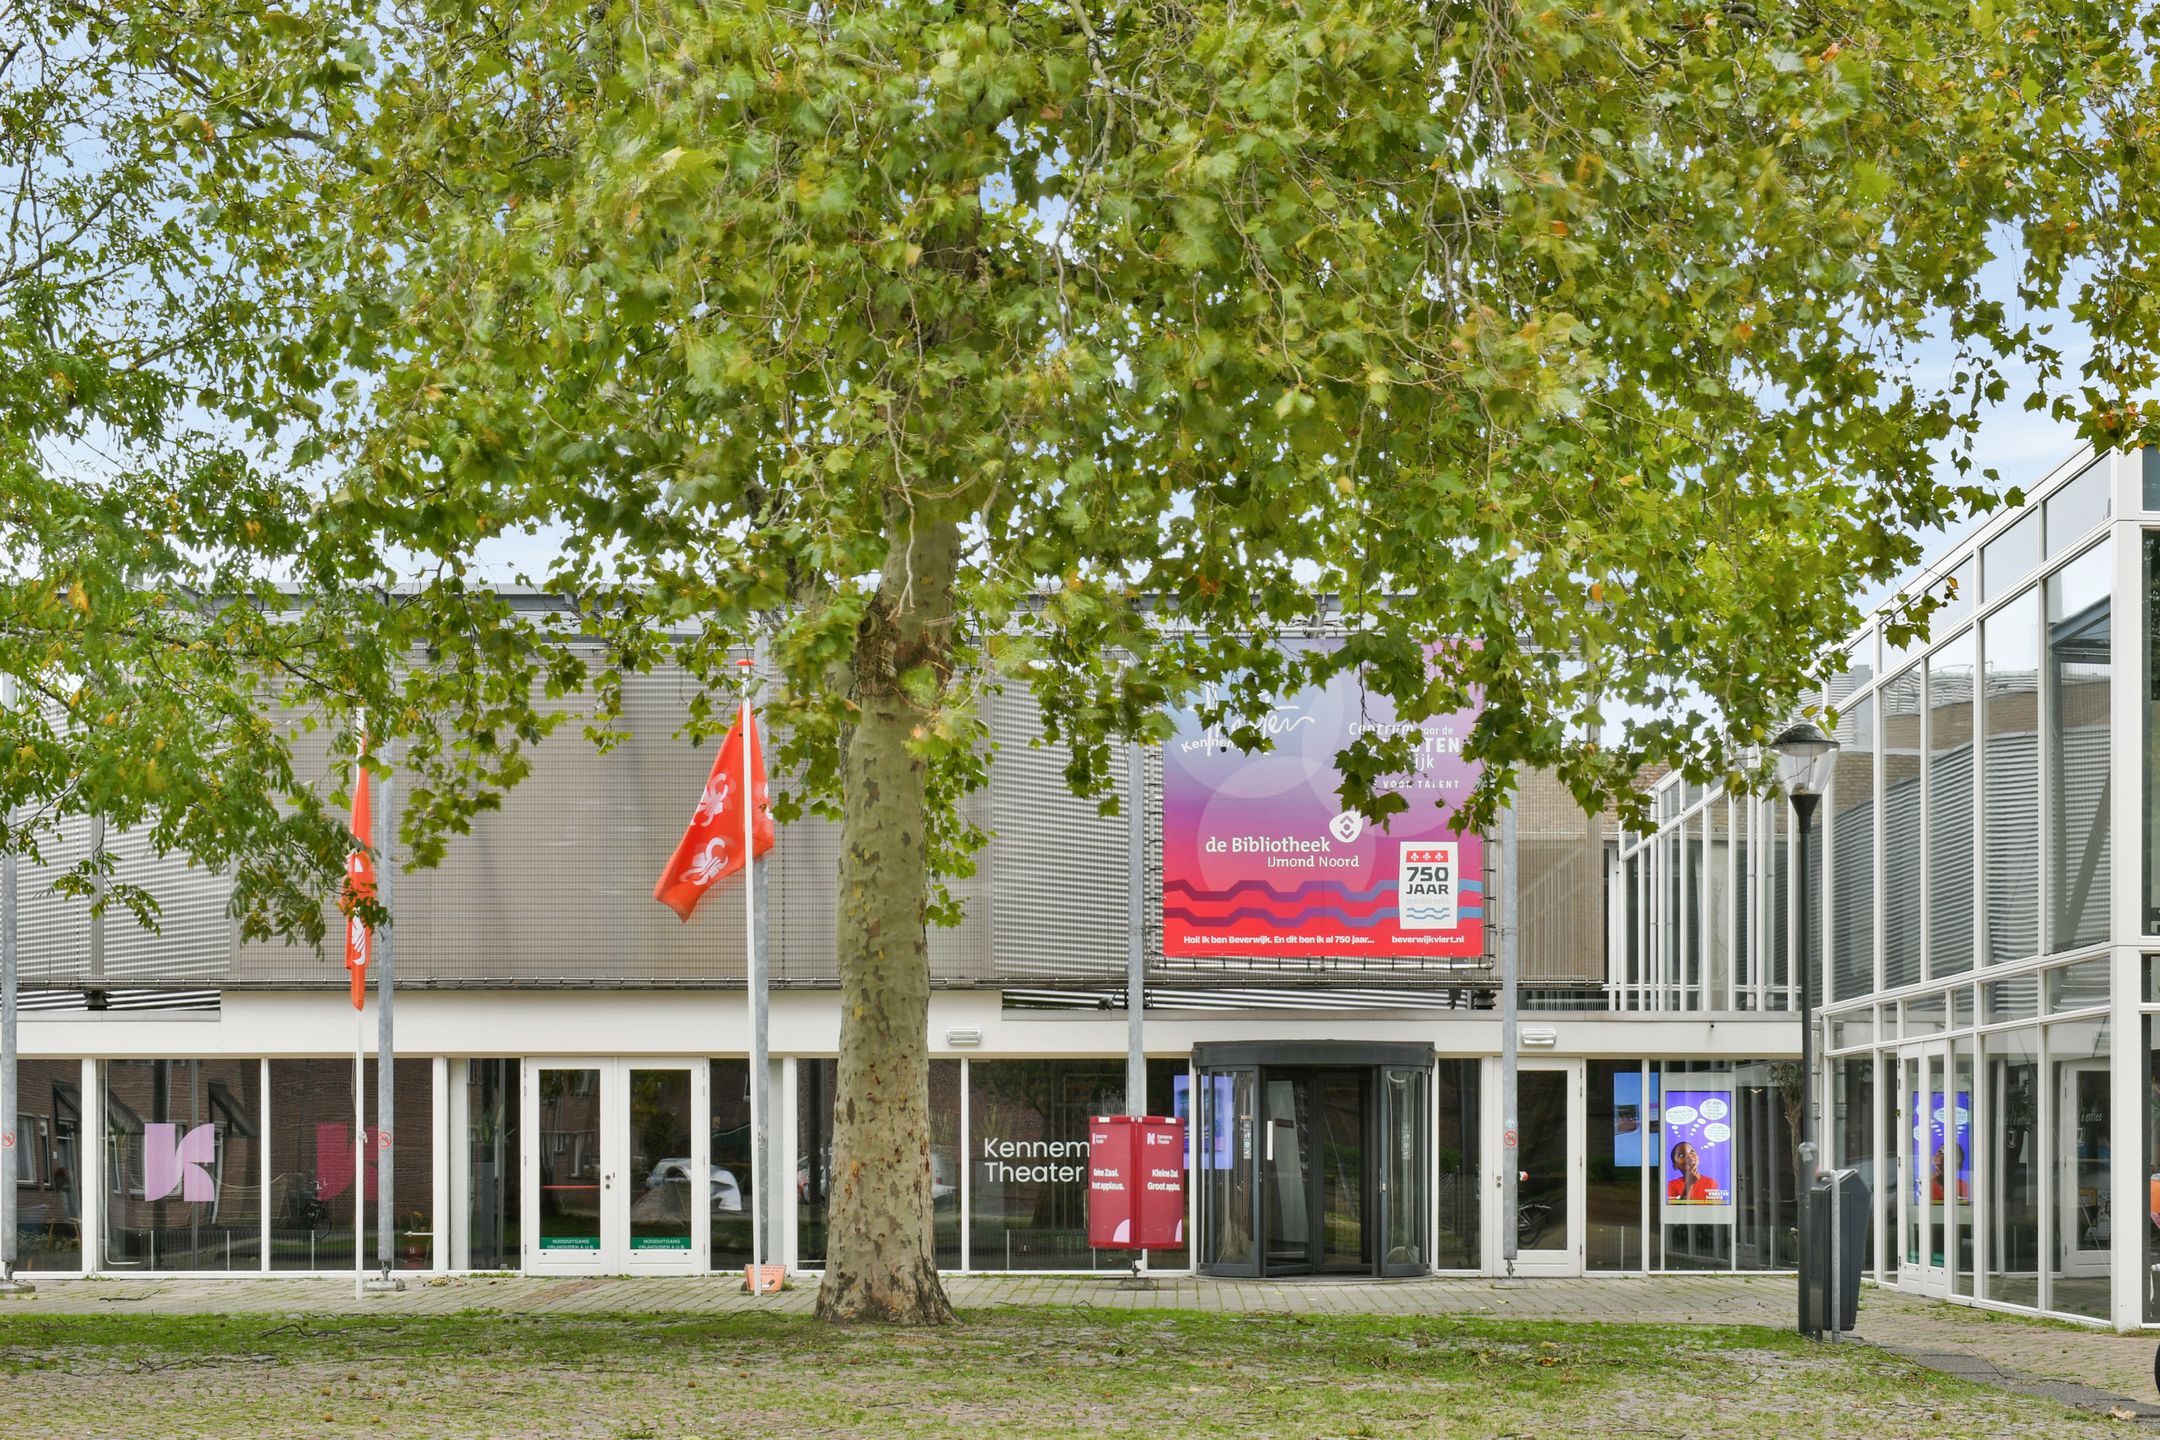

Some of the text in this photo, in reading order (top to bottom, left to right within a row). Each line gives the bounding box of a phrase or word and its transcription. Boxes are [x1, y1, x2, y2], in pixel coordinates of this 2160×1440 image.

[1421, 727, 1439, 736] oor
[1442, 725, 1454, 735] de
[1418, 780, 1460, 789] TALENT
[1205, 836, 1331, 853] de Bibliotheek
[1267, 855, 1360, 868] IJmond Noord
[1406, 866, 1449, 882] 750
[1406, 884, 1449, 895] JAAR
[1183, 935, 1376, 945] Hoi! Ik ben Beverwijk. En dit ben ik al 750 jaar...
[1391, 935, 1465, 945] beverwijkviert.nl
[984, 1161, 1085, 1183] Theater
[1151, 1168, 1170, 1178] Kleine
[1147, 1181, 1166, 1191] Groot
